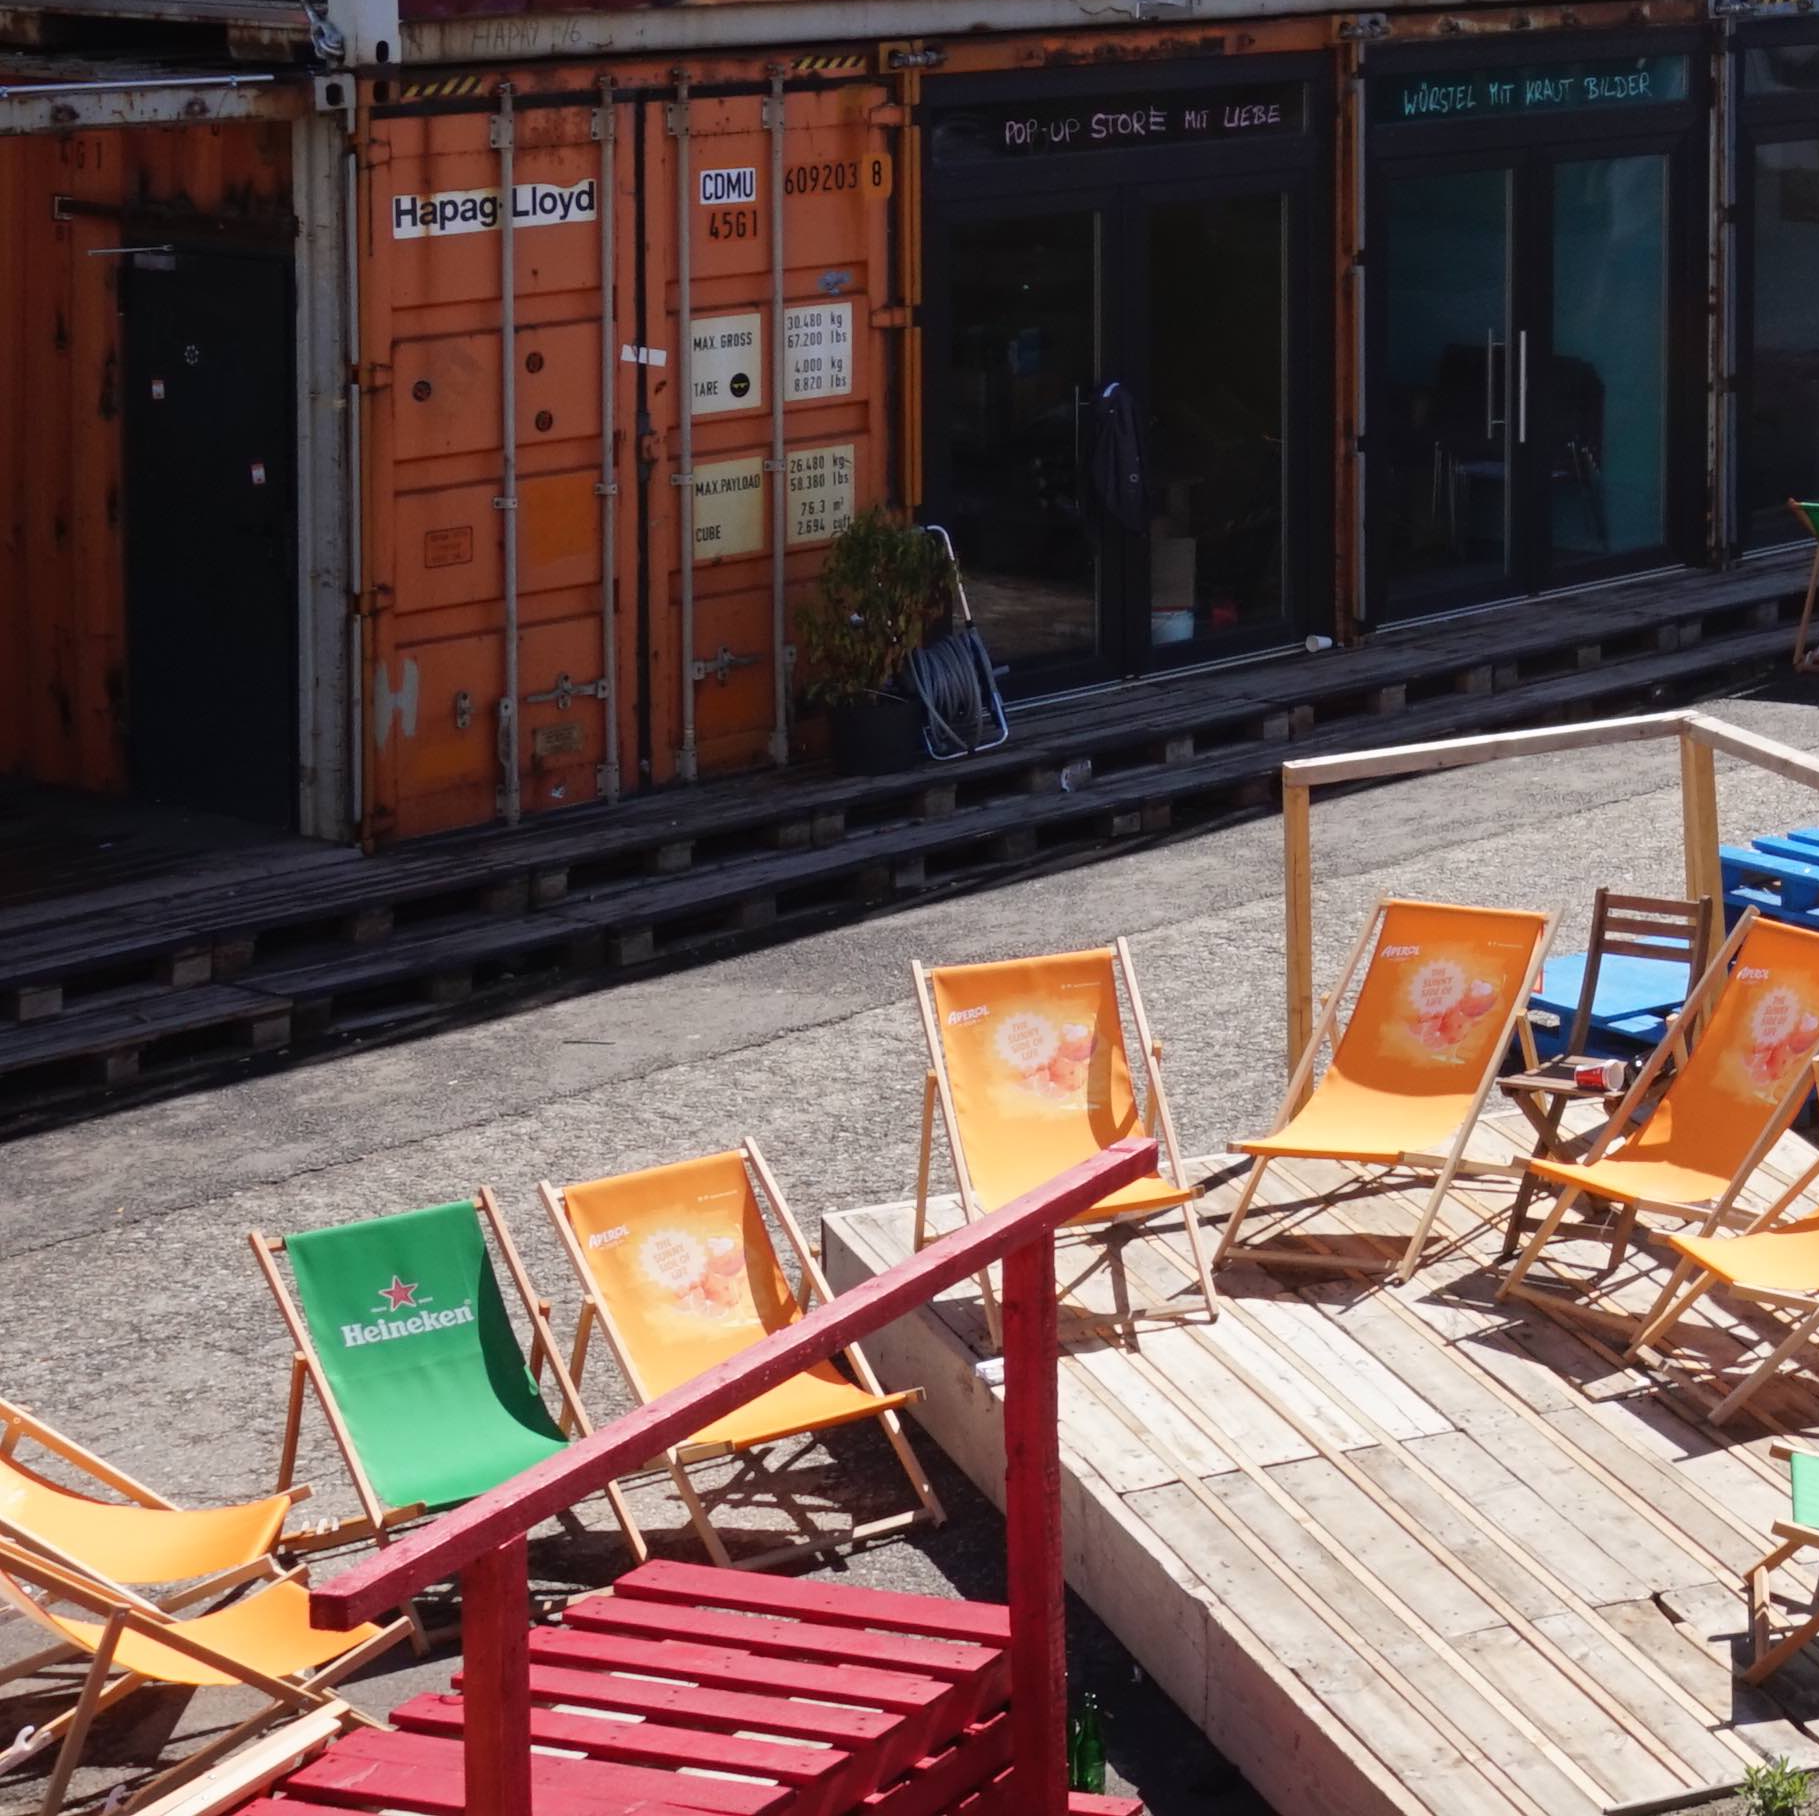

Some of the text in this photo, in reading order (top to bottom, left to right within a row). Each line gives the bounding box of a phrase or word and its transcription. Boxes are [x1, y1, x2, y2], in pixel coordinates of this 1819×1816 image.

[1404, 72, 1653, 116] WÜRSTEL MIT KRAUT BILDER
[1004, 103, 1281, 145] POP-UP STORE MIT LIEBE
[702, 160, 882, 201] CDMU 609203 8
[709, 210, 758, 239] 45G1
[787, 311, 843, 331] 30.480 kg
[693, 332, 753, 352] MAX. GROSS
[787, 329, 847, 349] 67.200 lbs
[794, 355, 843, 373] 4.000 kg
[694, 380, 719, 397] TARE
[794, 374, 847, 393] 8.820 lbs
[789, 453, 845, 474] 26.480 kg
[695, 473, 761, 497] MAX.PAYLOAD
[790, 472, 849, 492] 58.380 lbs
[801, 499, 825, 517] 76.3
[695, 524, 721, 543] CUBE
[797, 519, 825, 536] 2.694
[1381, 944, 1420, 958] APEROL
[948, 1004, 990, 1025] APEROL
[589, 1223, 630, 1249] APEROL
[340, 1300, 476, 1348] Heineken
